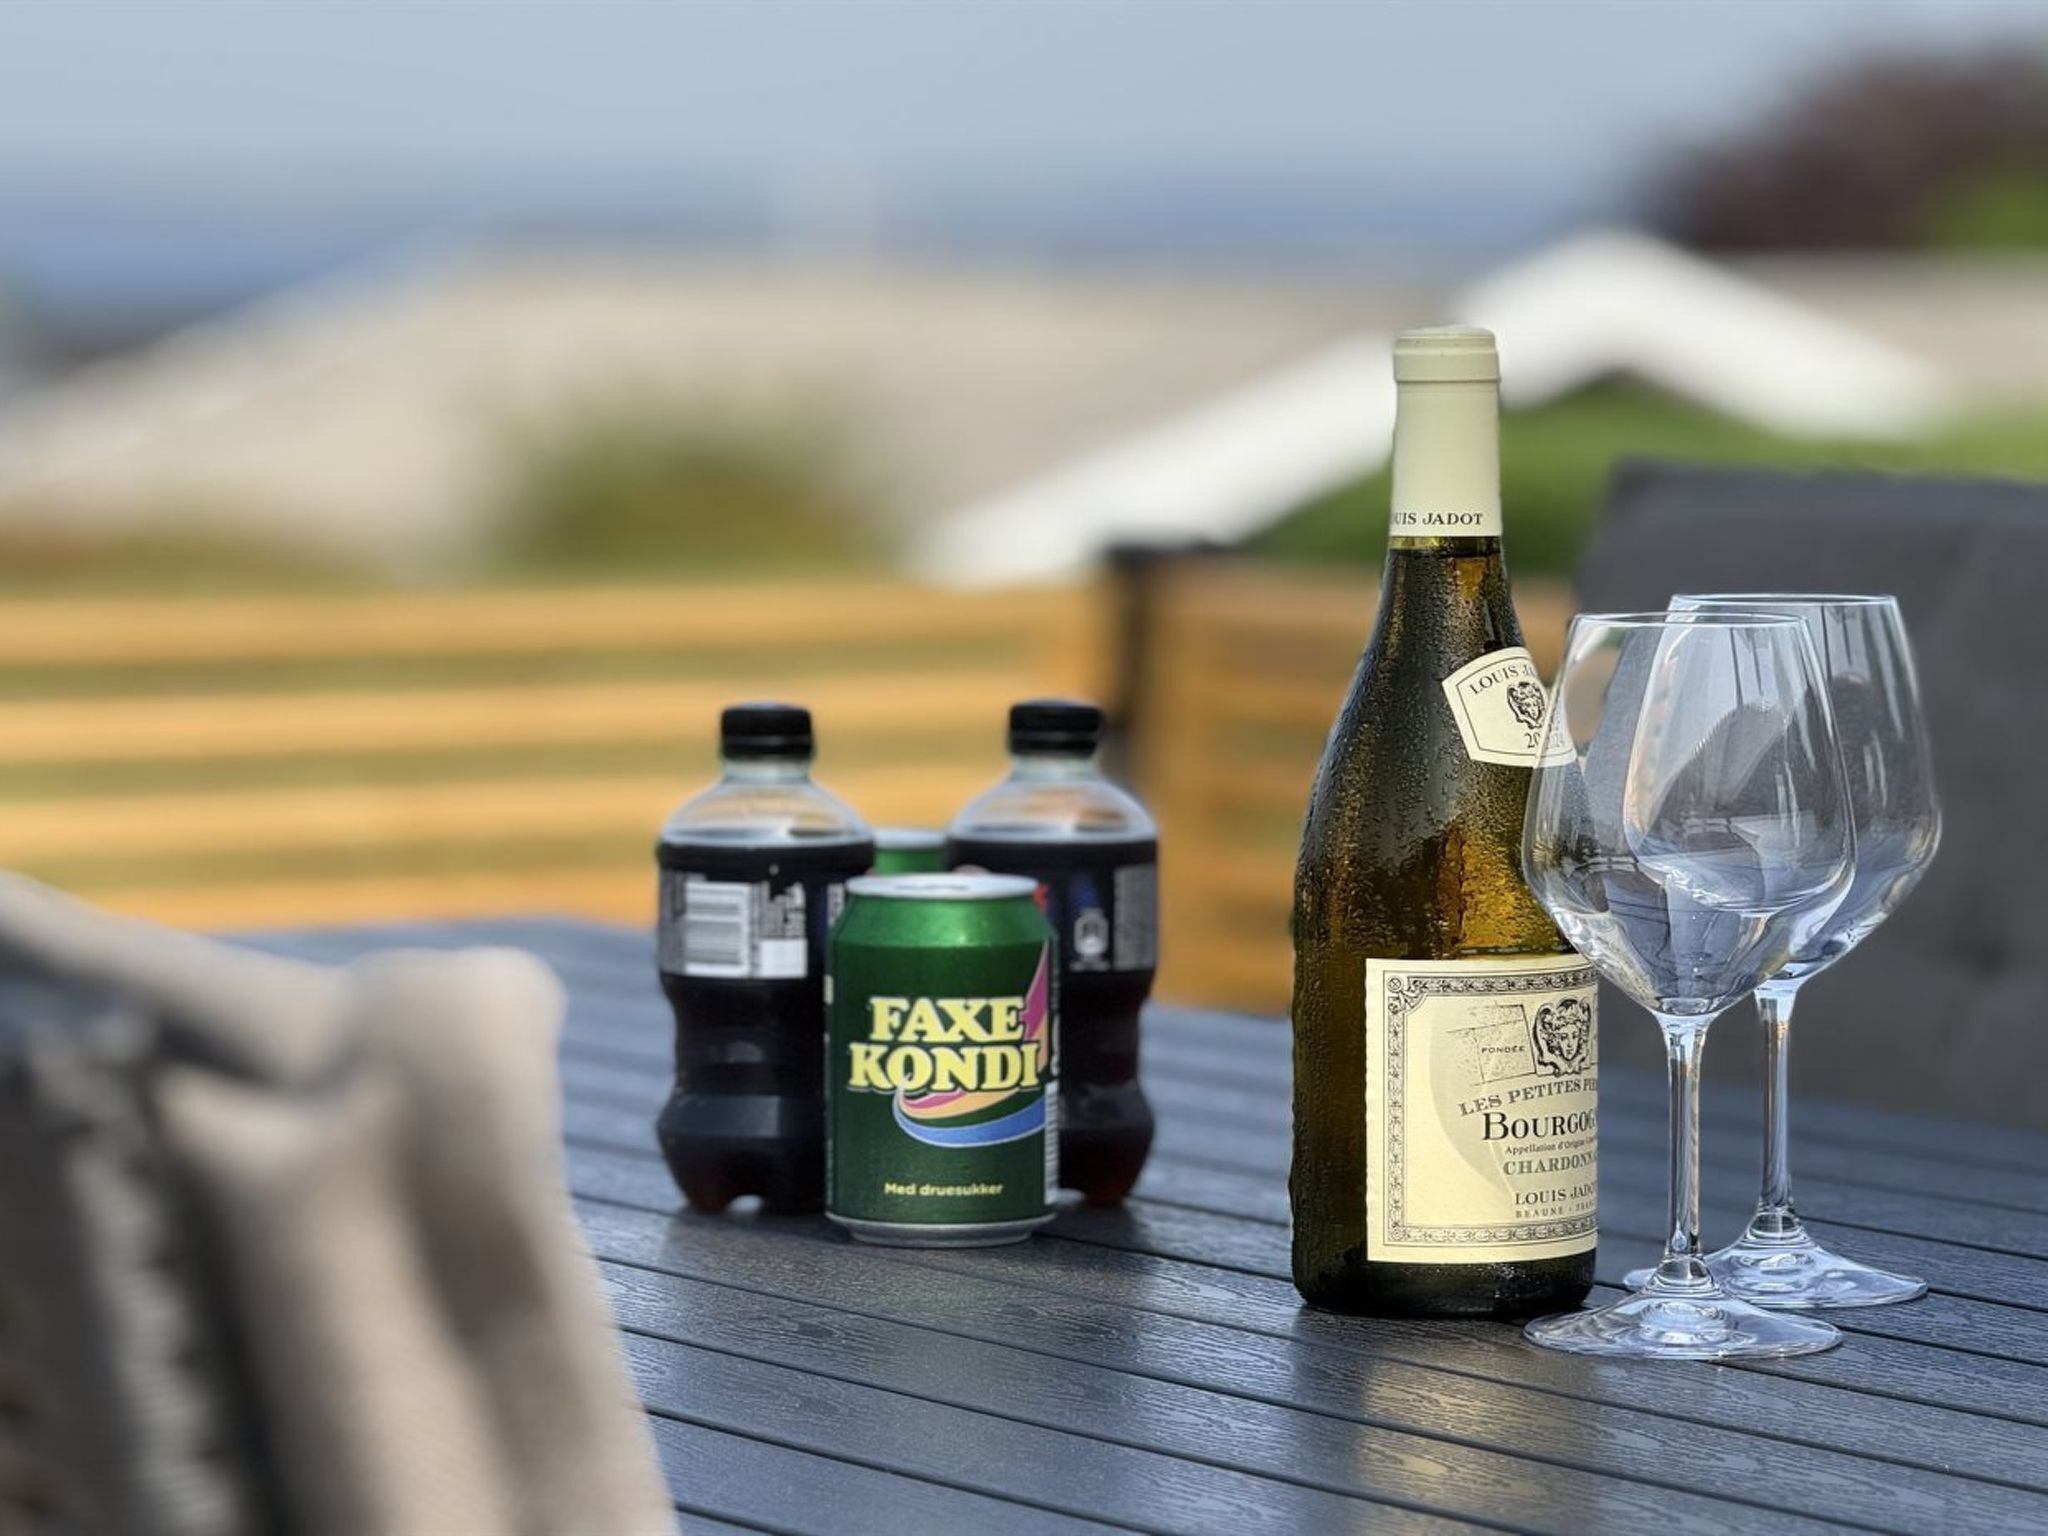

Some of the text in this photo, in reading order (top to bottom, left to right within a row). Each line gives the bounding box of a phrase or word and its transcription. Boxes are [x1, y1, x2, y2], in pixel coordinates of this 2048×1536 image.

[1422, 511, 1482, 526] JADOT
[1468, 664, 1520, 696] LOUIS
[869, 996, 1025, 1043] FAXE
[848, 1042, 1040, 1091] KONDI
[1458, 1094, 1502, 1117] LES
[1507, 1078, 1581, 1104] PETITES
[1505, 1144, 1556, 1156] Appellation
[884, 1182, 1003, 1196] Med druesukker
[1515, 1189, 1567, 1206] LOUIS
[1516, 1207, 1563, 1218] BEAUNE
